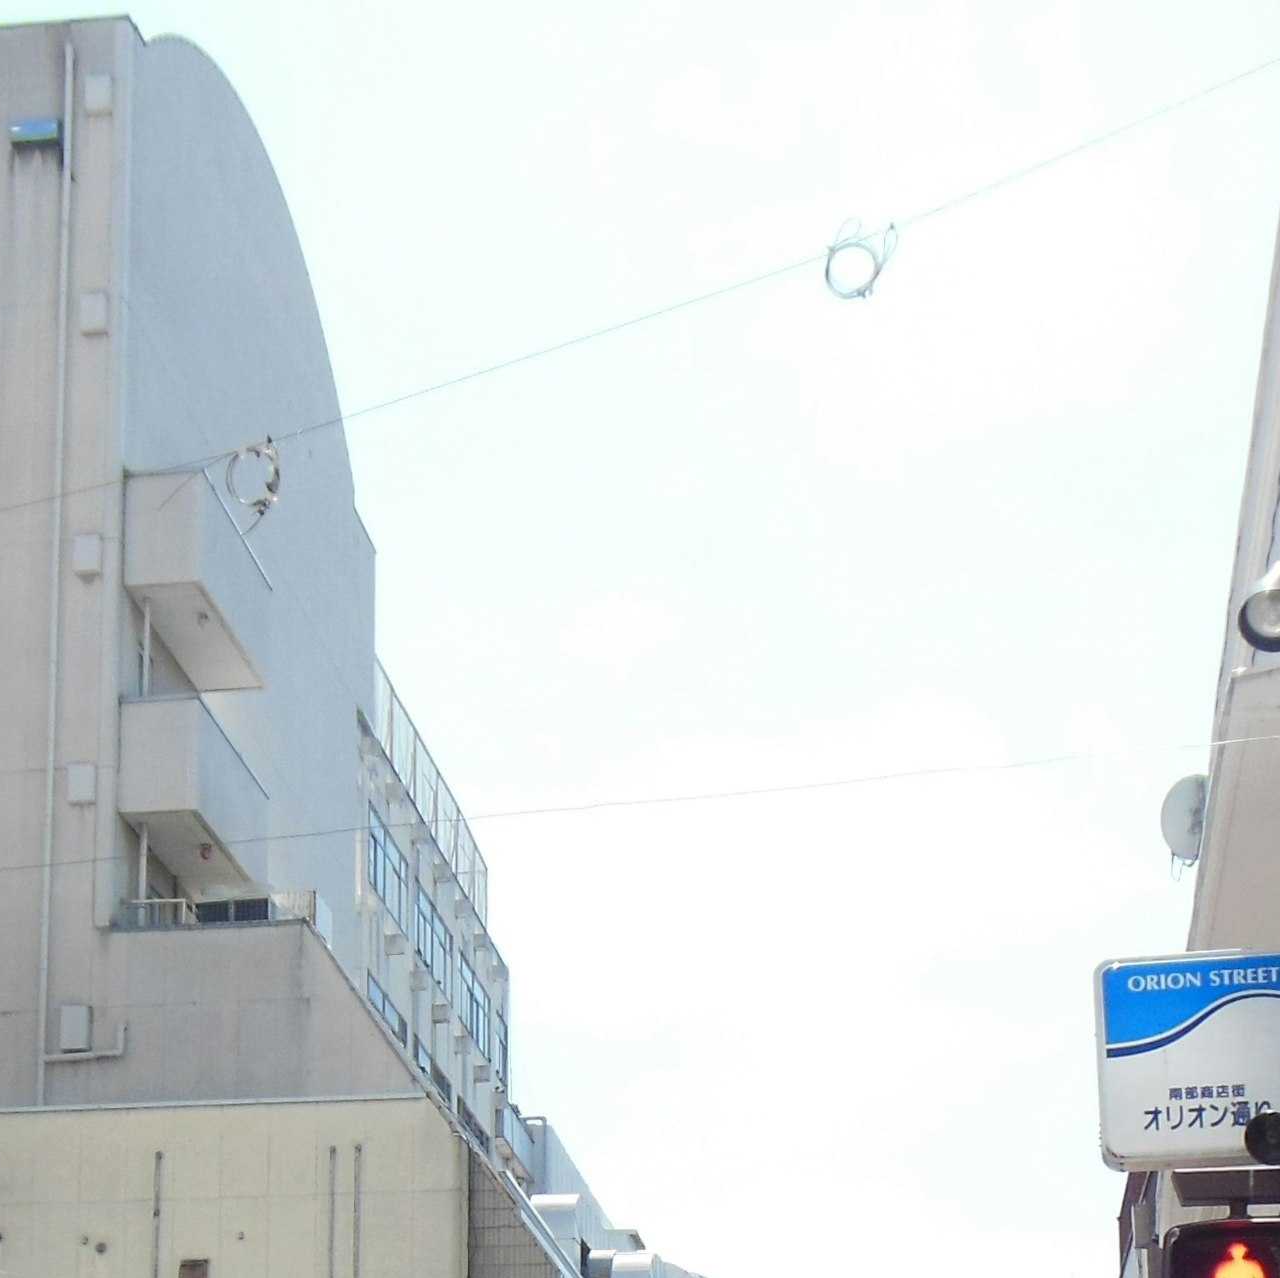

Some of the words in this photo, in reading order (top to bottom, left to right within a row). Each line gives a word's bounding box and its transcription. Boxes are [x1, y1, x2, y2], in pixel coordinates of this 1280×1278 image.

[1127, 971, 1202, 992] ORION
[1209, 966, 1280, 986] STREET
[1169, 1084, 1245, 1100] 南部商店街
